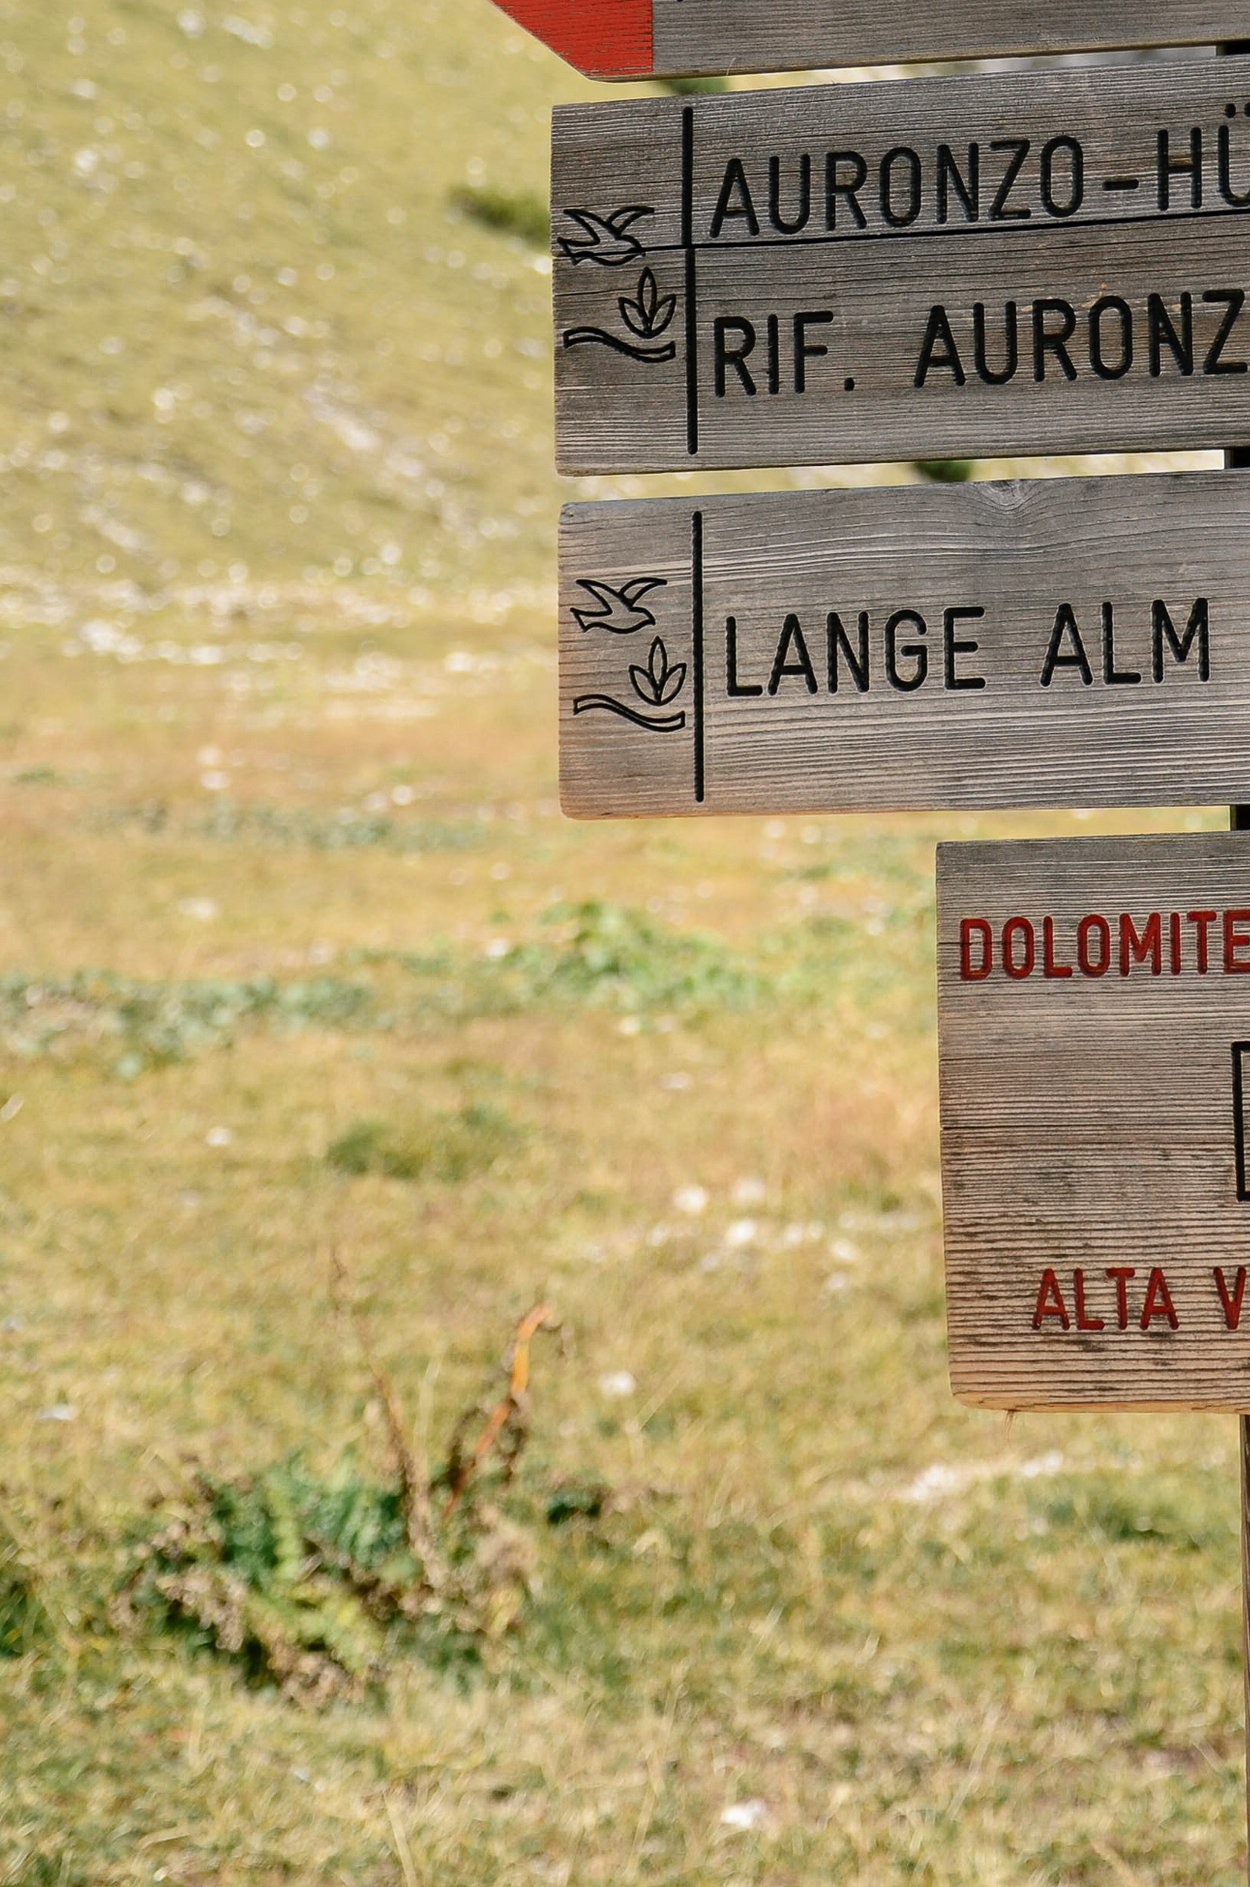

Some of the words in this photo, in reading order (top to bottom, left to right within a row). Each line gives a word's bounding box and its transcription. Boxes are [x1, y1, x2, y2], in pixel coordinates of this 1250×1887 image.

[713, 311, 857, 397] RIF.
[725, 606, 986, 698] LANGE
[1040, 597, 1210, 687] ALM
[1032, 1267, 1179, 1332] ALTA
